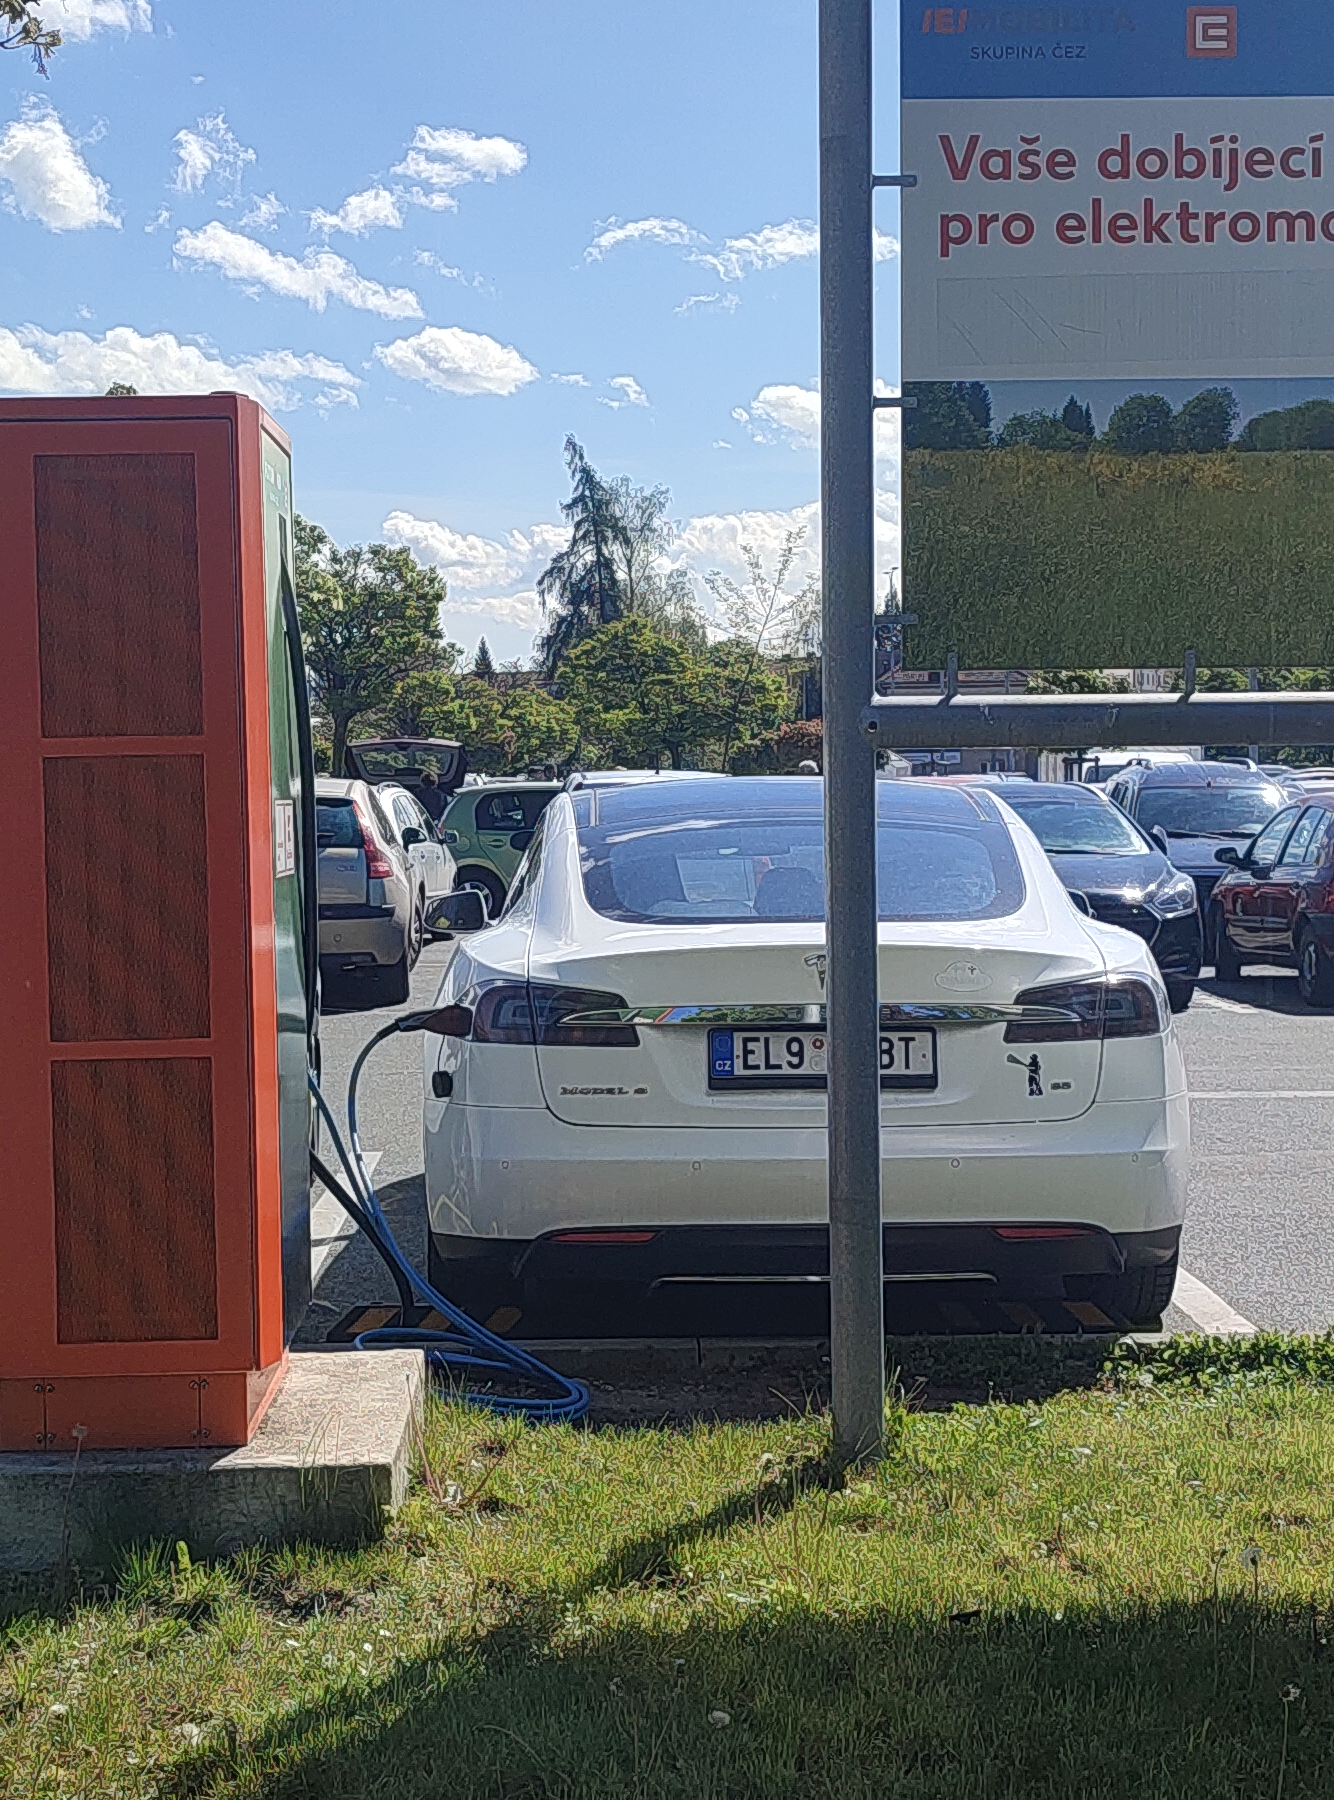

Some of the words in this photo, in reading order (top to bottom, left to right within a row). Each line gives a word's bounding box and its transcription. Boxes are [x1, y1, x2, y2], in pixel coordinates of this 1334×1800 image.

[969, 46, 1046, 60] SKUPINA
[1052, 42, 1087, 60] ČEZ
[937, 133, 1077, 181] Vaše
[1097, 132, 1325, 193] dobíjecí
[939, 209, 1036, 258] pro
[715, 1060, 732, 1071] CZ
[741, 1036, 805, 1071] EL9
